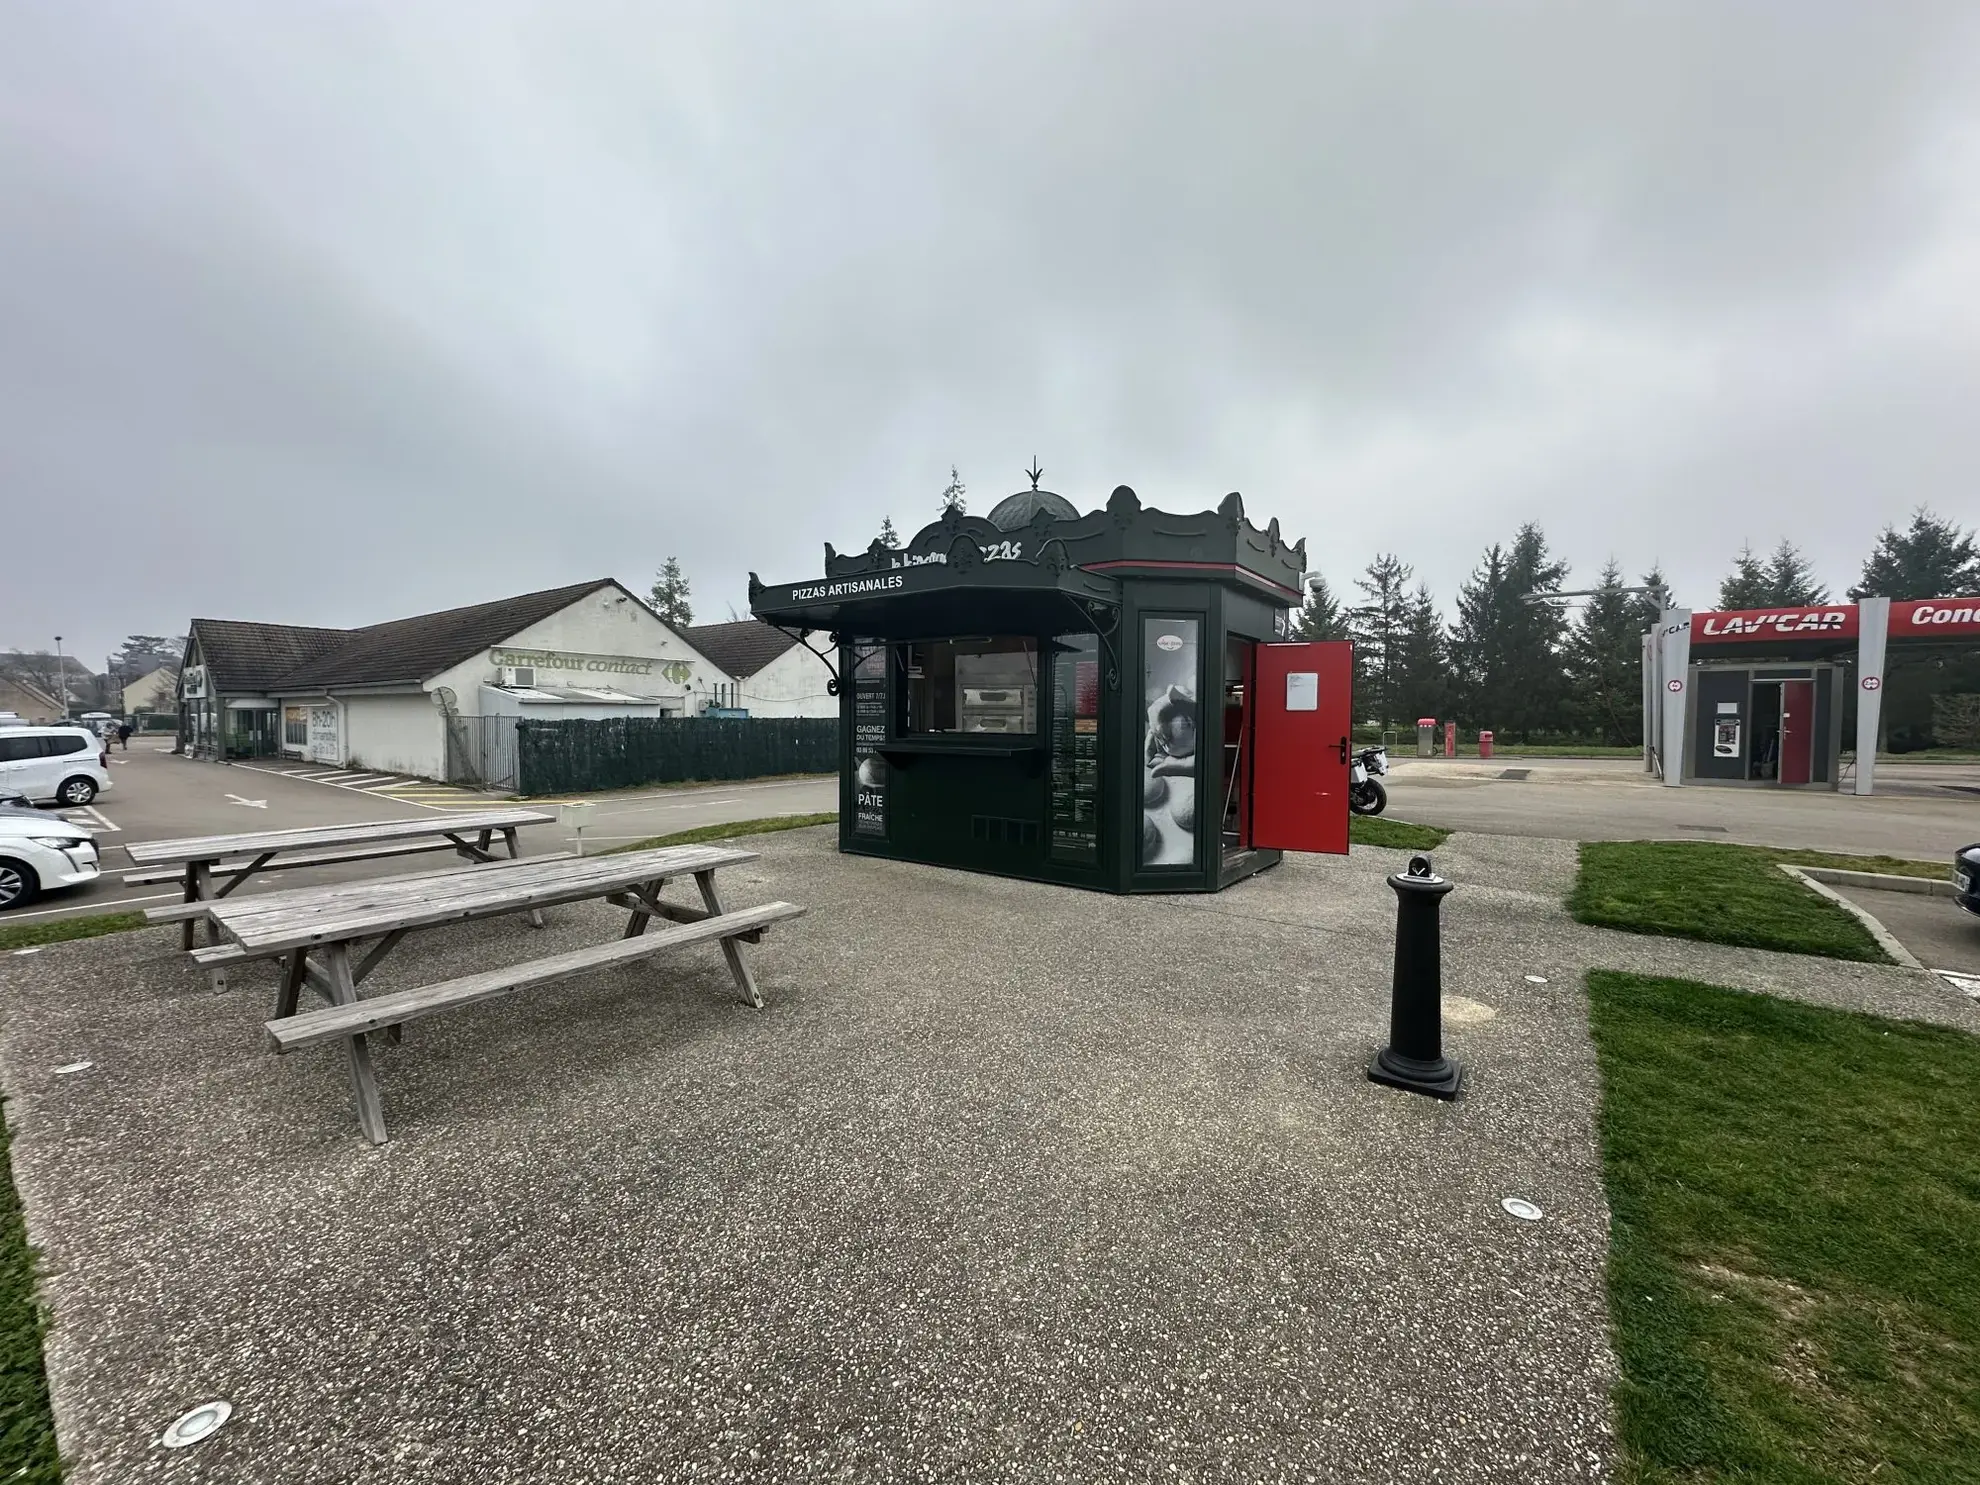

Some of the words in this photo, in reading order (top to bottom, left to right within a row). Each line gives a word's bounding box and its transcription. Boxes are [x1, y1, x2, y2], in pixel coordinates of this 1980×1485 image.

[792, 586, 826, 601] PIZZAS
[828, 575, 903, 597] ARTISANALES
[1703, 612, 1846, 636] LAV'CAR
[488, 649, 586, 671] Carrefour
[586, 658, 653, 676] contact
[856, 725, 885, 734] GAGNEZ
[858, 791, 883, 807] PÂTE
